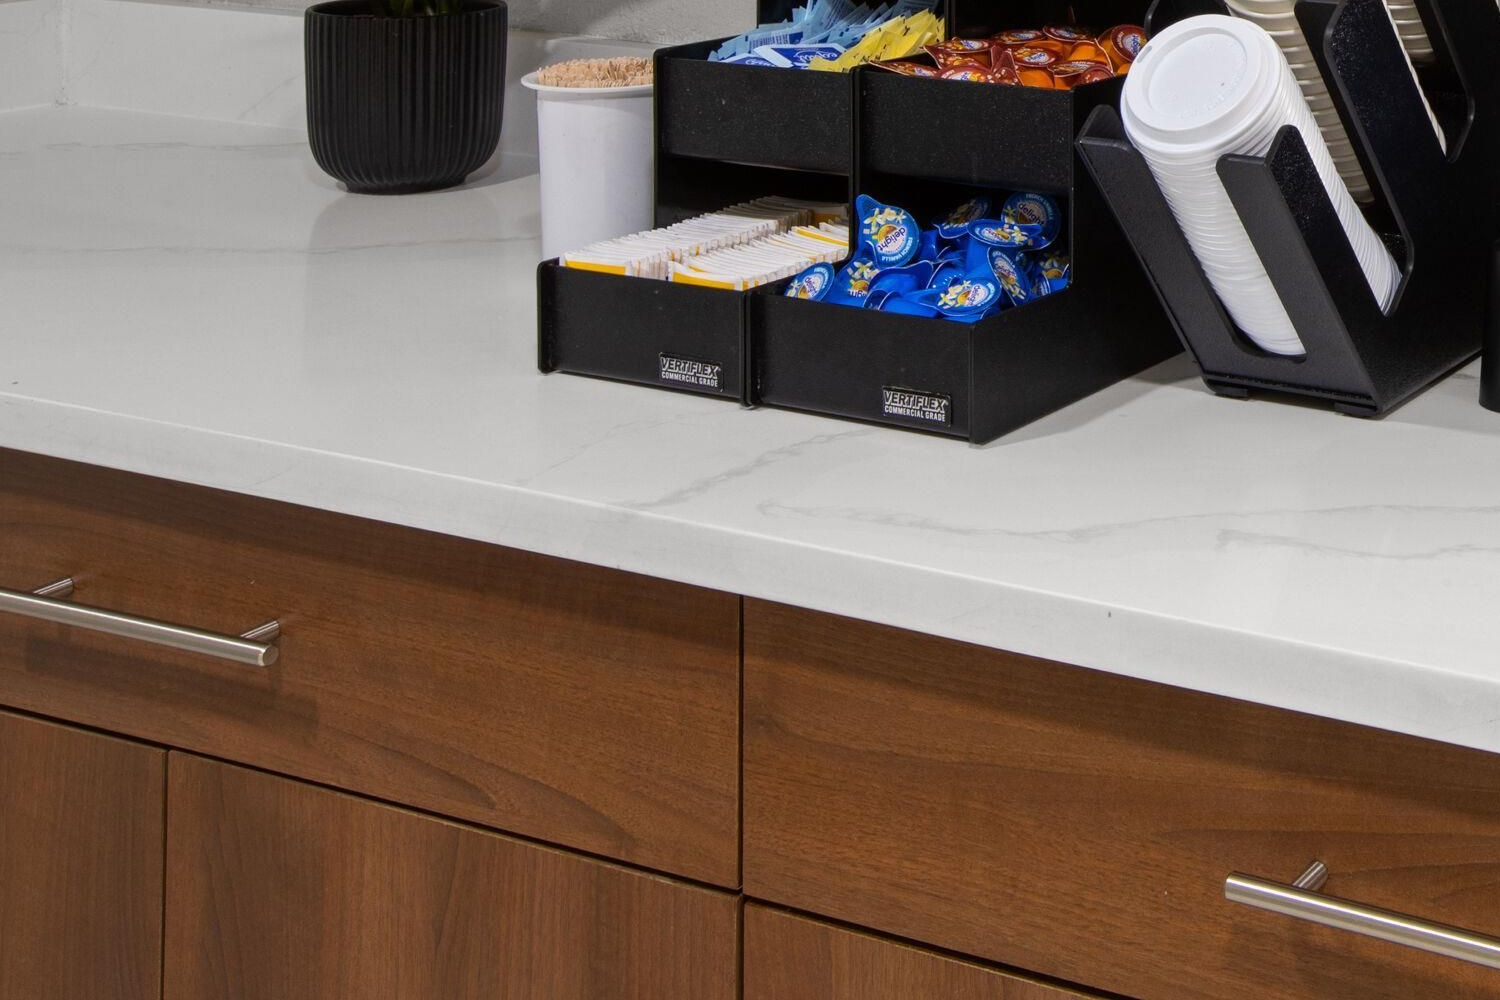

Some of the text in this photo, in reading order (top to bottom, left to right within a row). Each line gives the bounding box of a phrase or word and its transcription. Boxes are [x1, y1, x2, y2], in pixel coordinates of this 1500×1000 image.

[877, 226, 906, 252] delight
[660, 356, 719, 379] VERTIFLEX
[661, 371, 718, 387] COMMERCIAL GRADE
[883, 390, 946, 413] VERTIFLEX
[884, 405, 946, 422] COMMERCIAL GRADE
